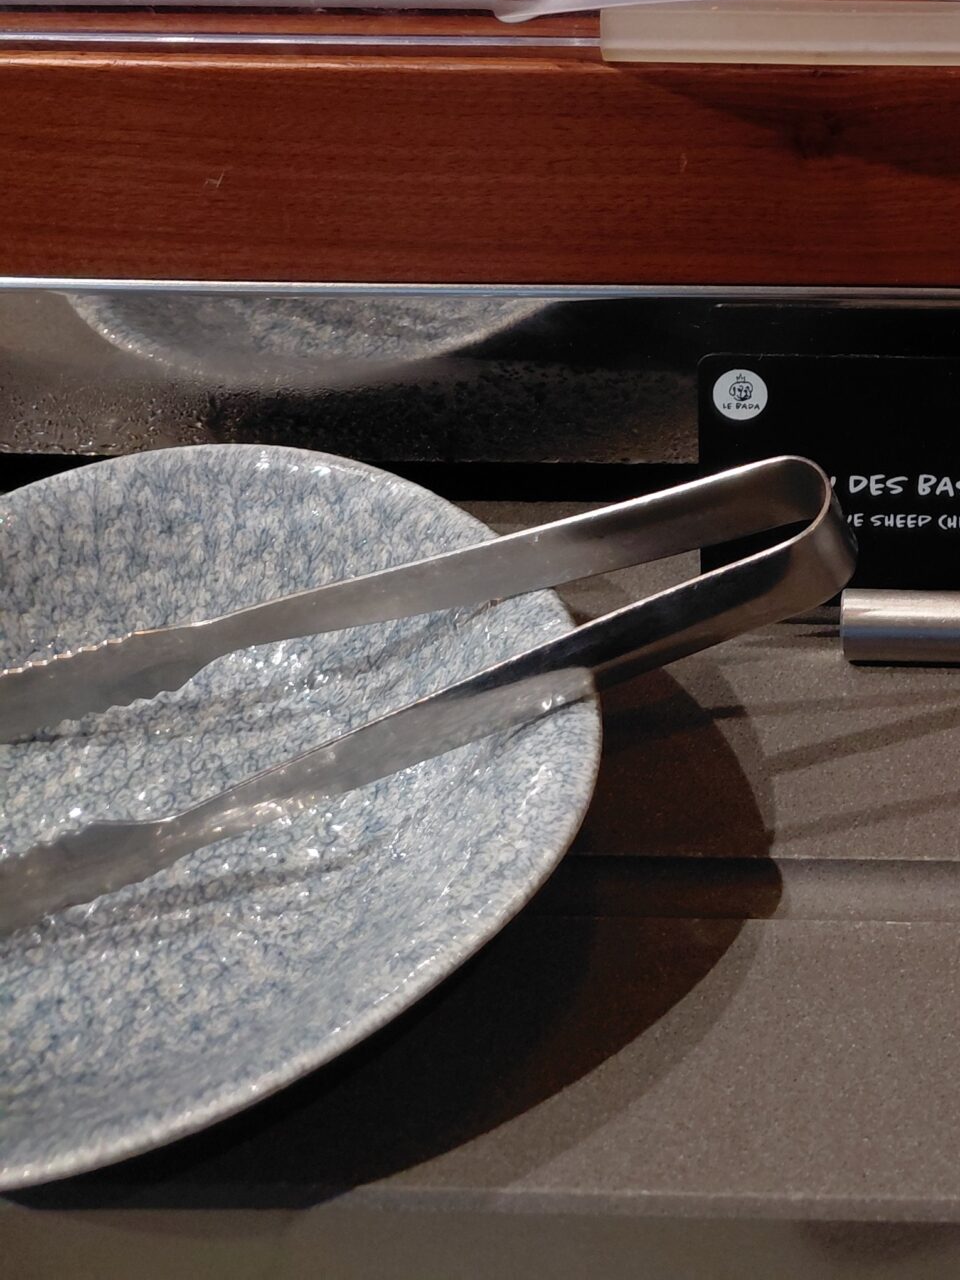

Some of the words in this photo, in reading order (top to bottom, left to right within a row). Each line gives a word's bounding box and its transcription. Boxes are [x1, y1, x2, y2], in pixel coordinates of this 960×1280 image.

[722, 402, 733, 410] LE
[848, 474, 909, 496] DES
[869, 513, 933, 528] SHEEP
